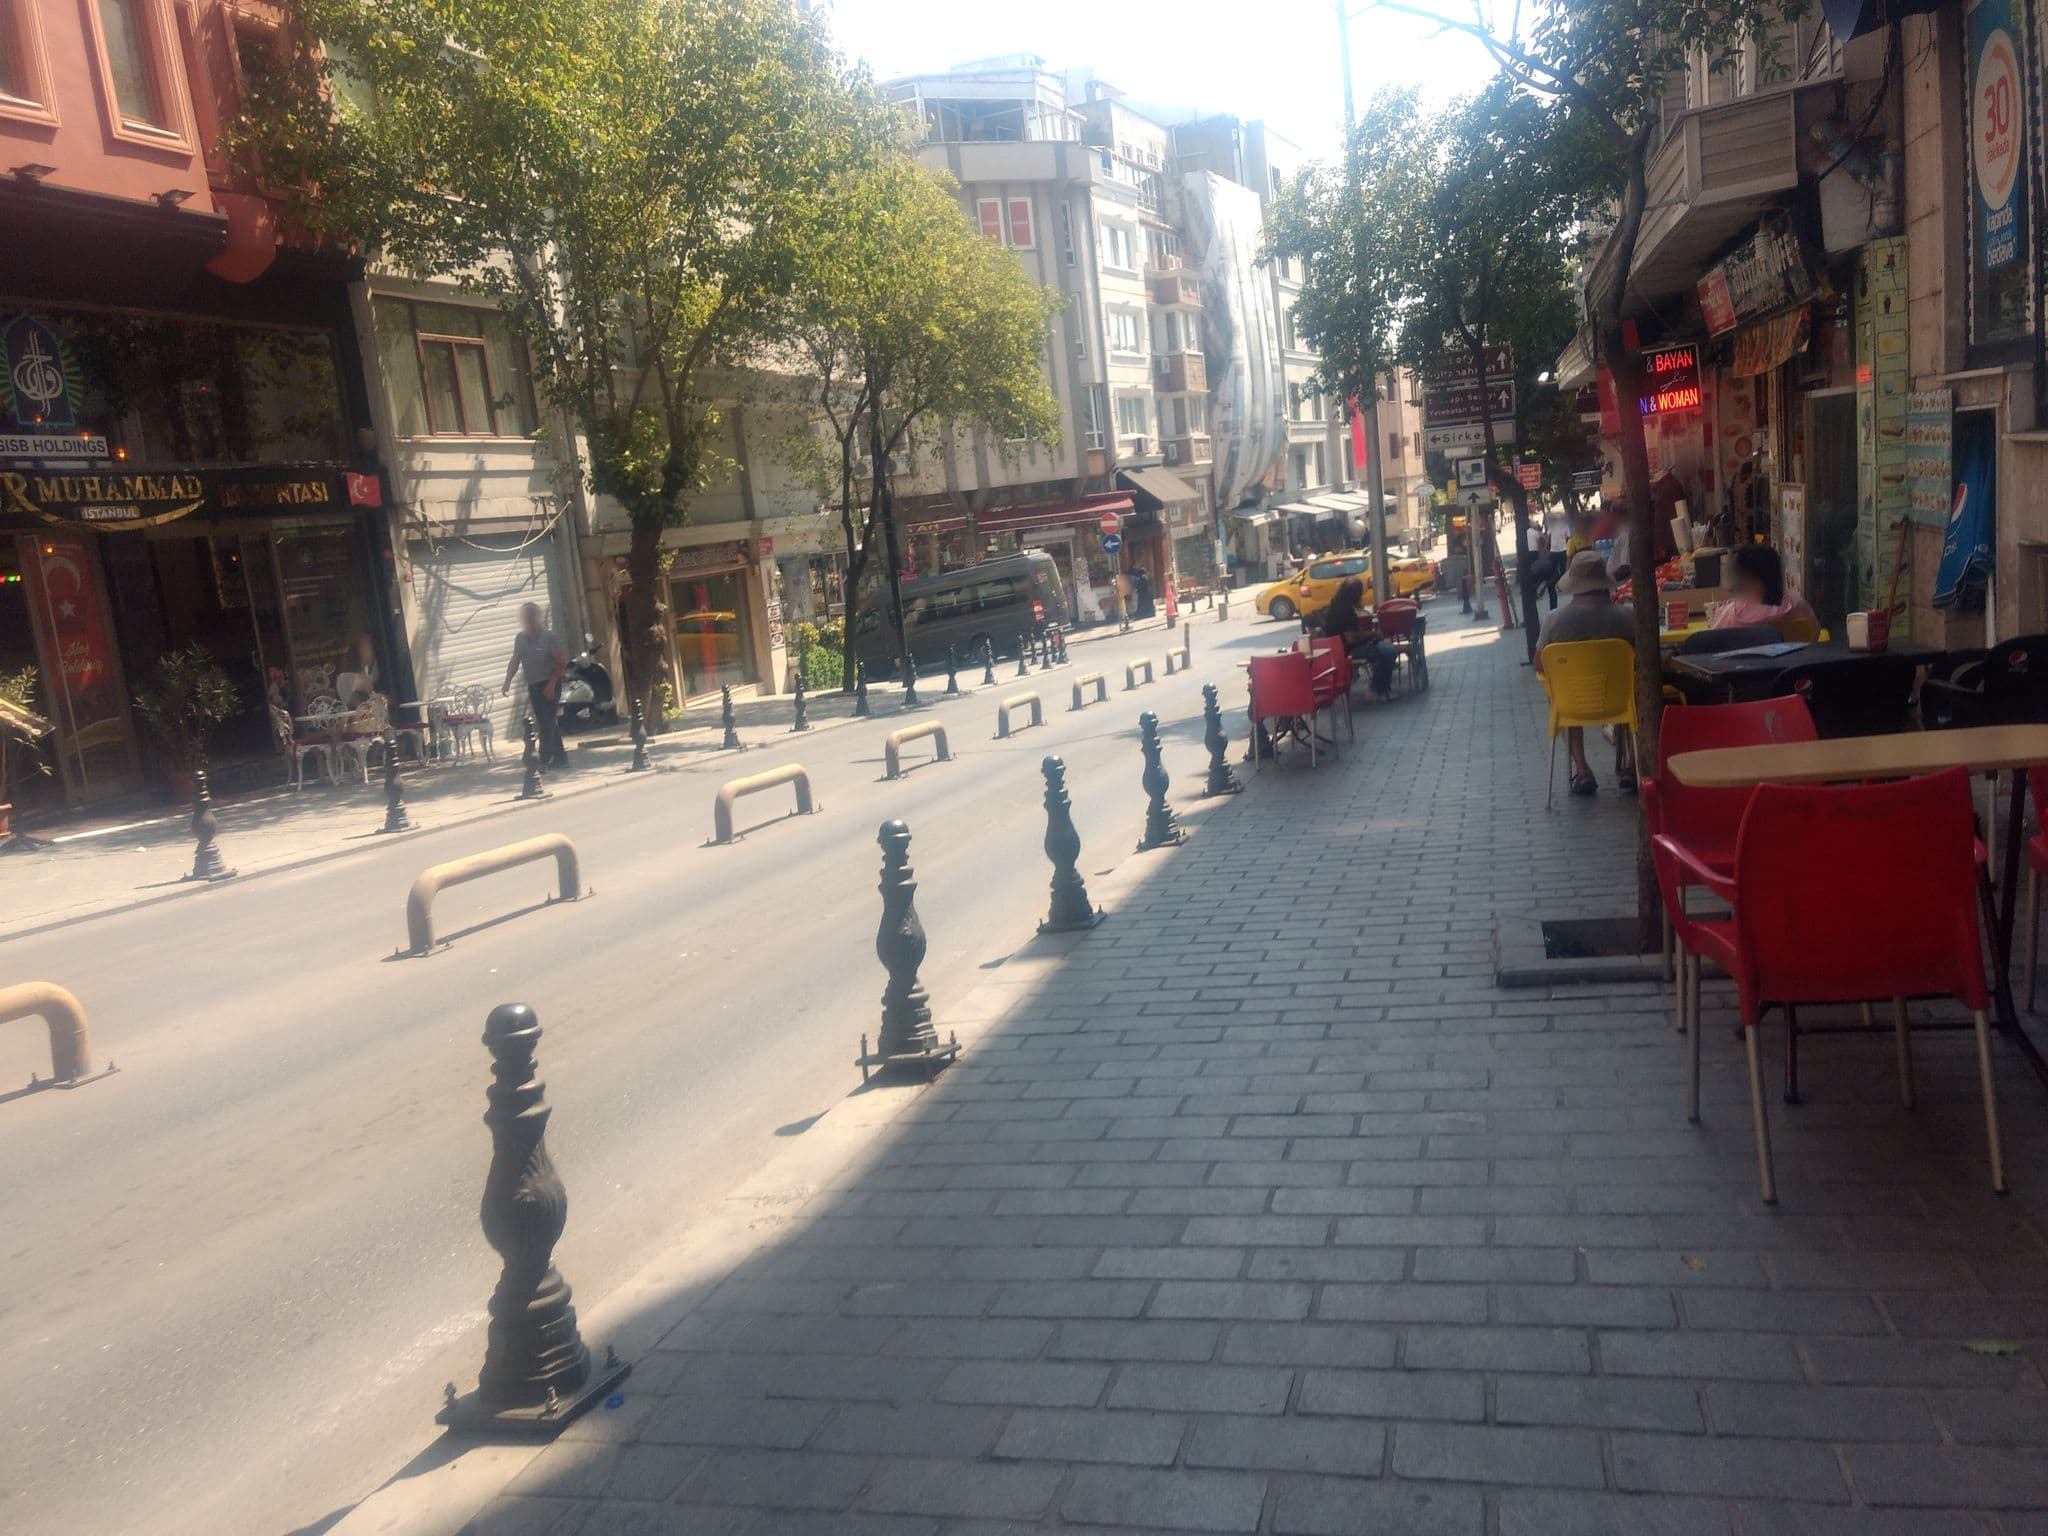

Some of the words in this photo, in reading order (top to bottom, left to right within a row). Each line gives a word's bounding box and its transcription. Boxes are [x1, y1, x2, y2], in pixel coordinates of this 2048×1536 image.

[1984, 75, 2010, 144] 30
[1655, 349, 1694, 373] BAYAN
[1649, 395, 1657, 412] &
[1657, 387, 1699, 410] WOMAN
[33, 438, 106, 453] HOLDINGS
[34, 474, 204, 504] MUHAMMAD
